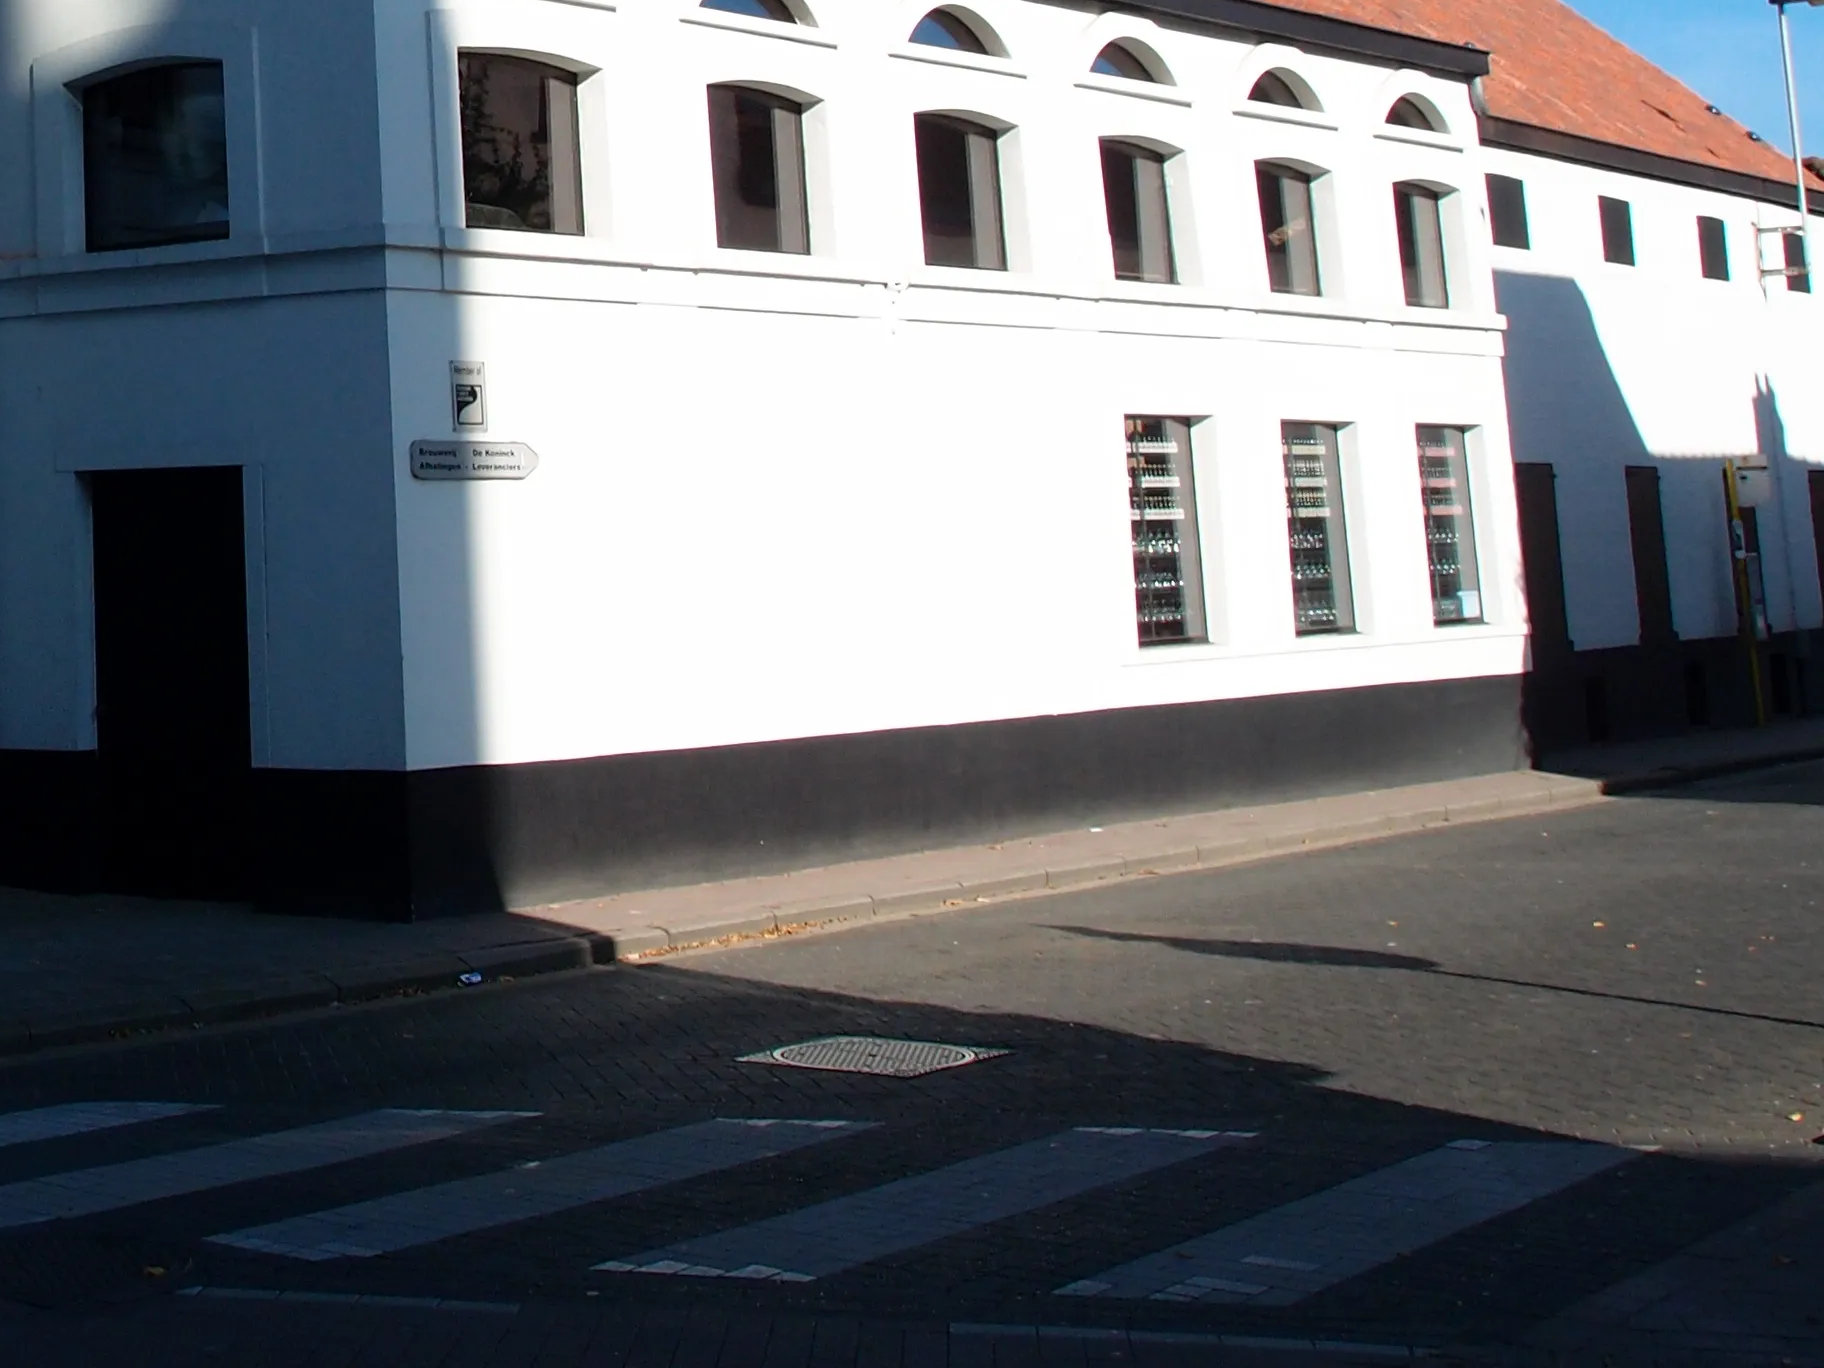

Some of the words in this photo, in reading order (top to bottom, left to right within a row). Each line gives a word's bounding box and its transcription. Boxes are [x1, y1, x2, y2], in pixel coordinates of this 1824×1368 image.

[472, 449, 483, 457] De
[485, 449, 515, 458] Koninck
[472, 462, 521, 471] Leveranciers
